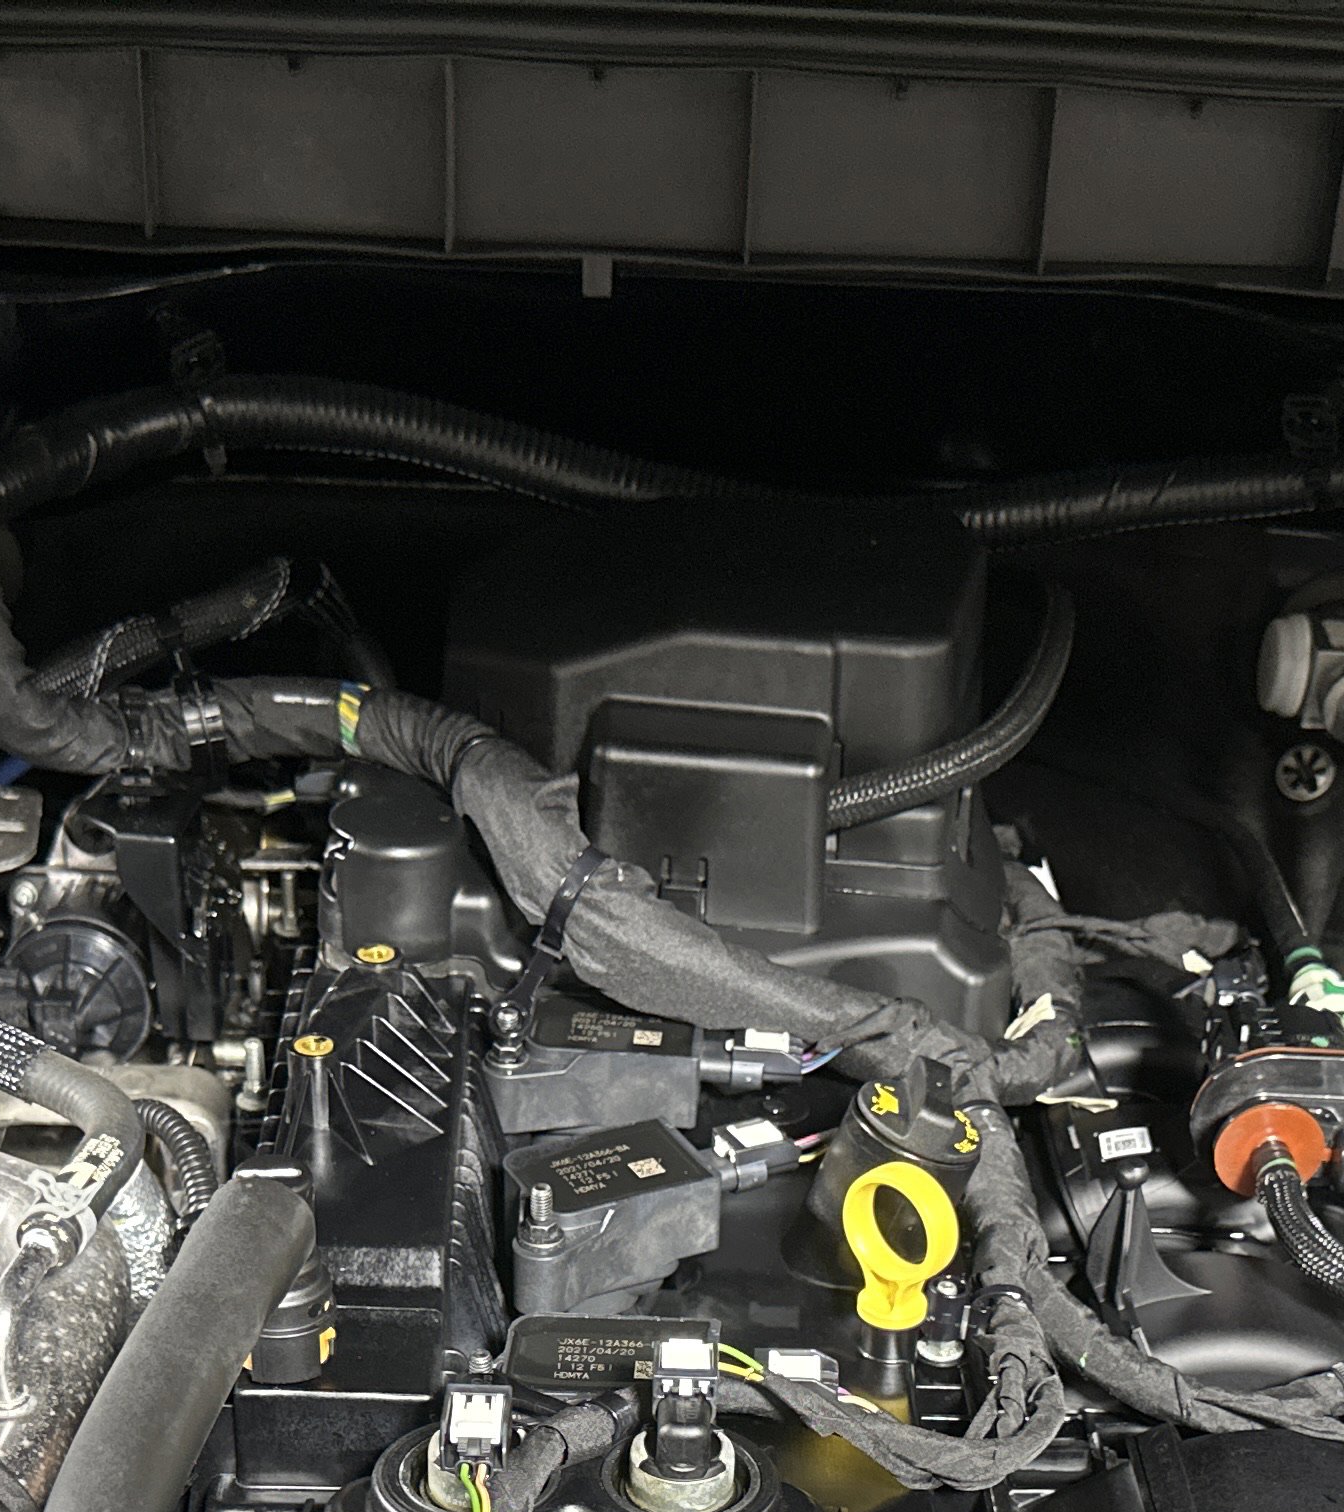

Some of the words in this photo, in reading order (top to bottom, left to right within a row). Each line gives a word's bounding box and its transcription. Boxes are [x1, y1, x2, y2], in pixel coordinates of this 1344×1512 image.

[556, 1155, 621, 1176] 2021/04/20
[558, 1338, 655, 1348] JX6E-12A366-
[558, 1346, 635, 1356] 2021/04/20
[571, 1363, 584, 1371] 12
